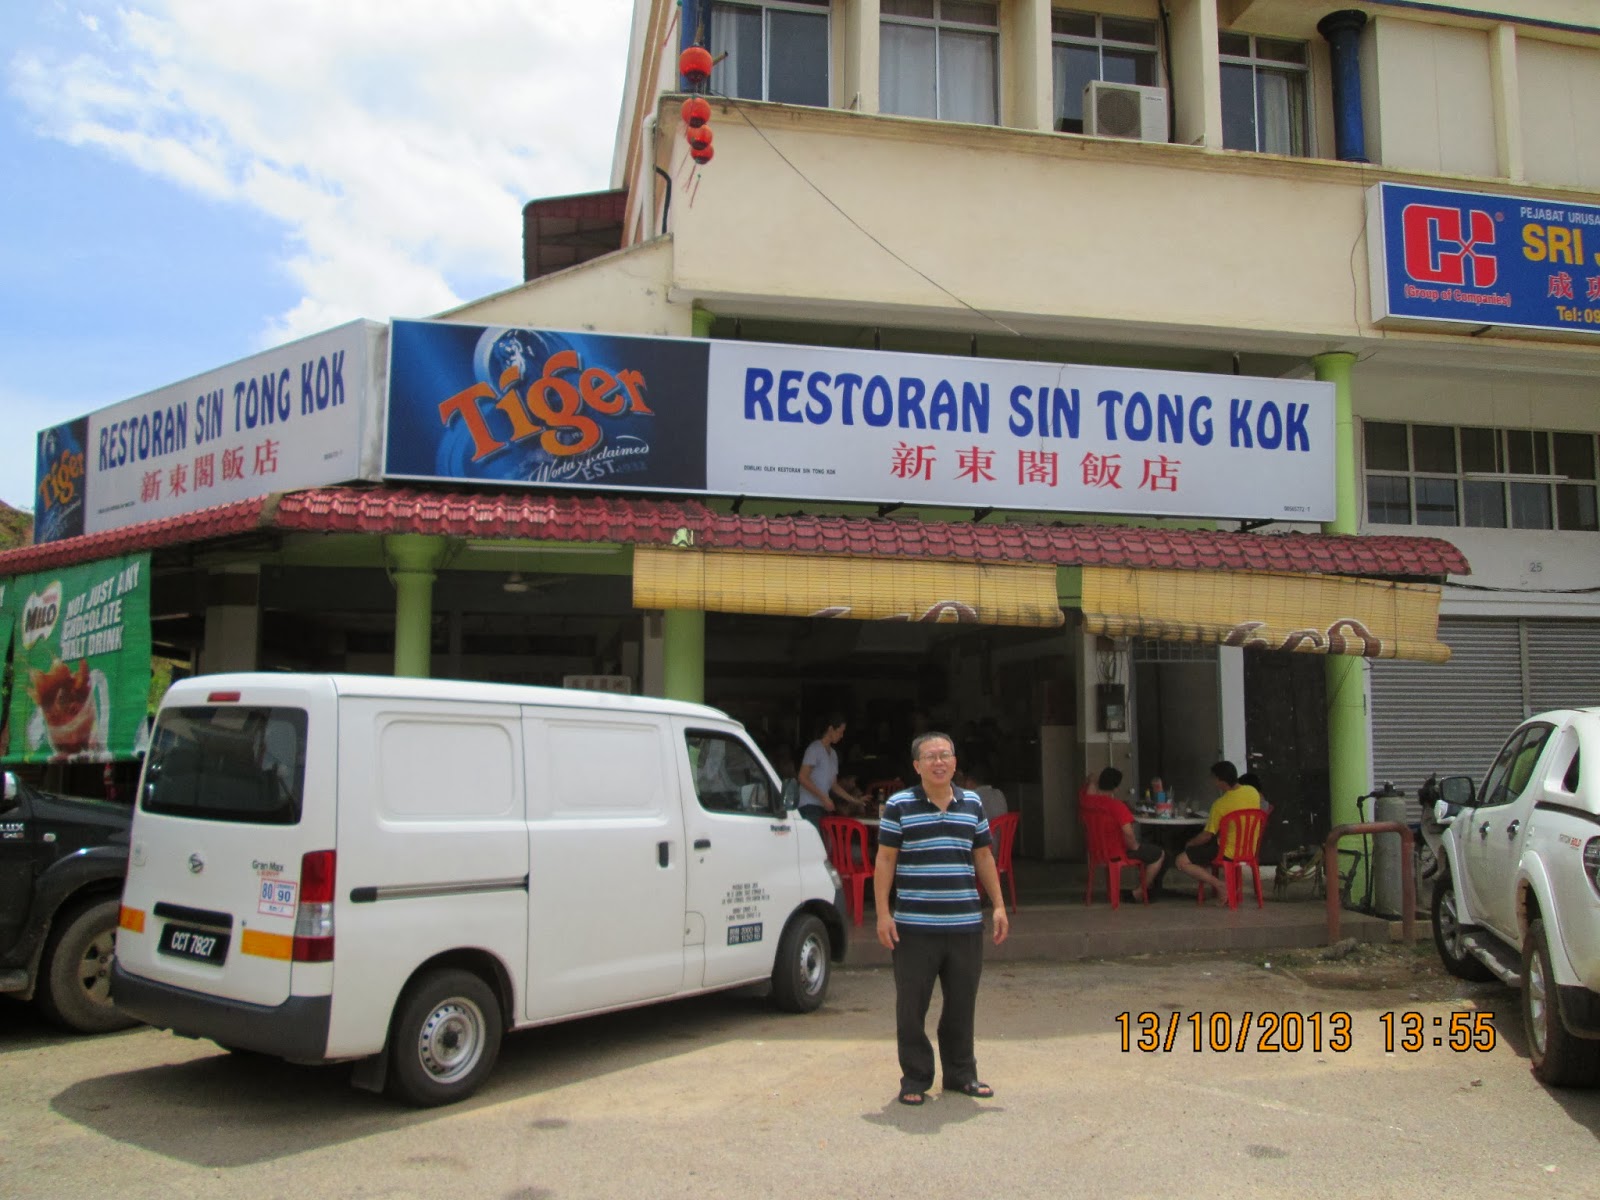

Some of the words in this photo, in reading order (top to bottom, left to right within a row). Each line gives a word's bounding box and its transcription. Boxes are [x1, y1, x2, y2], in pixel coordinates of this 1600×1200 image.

[1520, 206, 1564, 222] PEJABAT
[1522, 223, 1584, 265] SRI
[1441, 288, 1452, 300] of
[98, 401, 188, 471] RESTORAN
[195, 388, 224, 445] SIN
[234, 368, 290, 432] TONG
[301, 350, 345, 416] KOK
[438, 350, 655, 463] Tiger
[744, 367, 990, 433] RESTORAN
[1008, 385, 1080, 439] SIN
[1097, 390, 1214, 446] TONG
[1230, 399, 1310, 452] KOK
[39, 449, 84, 510] Tiger
[140, 439, 280, 503] 新東閣飯店
[890, 441, 1182, 492] 新東閣飯店
[66, 593, 86, 620] NOT
[87, 576, 115, 610] JUST
[117, 561, 140, 596] ANY
[25, 604, 57, 633] MILO
[61, 598, 123, 641] CHOCOLATE
[252, 860, 268, 870] Gran
[270, 862, 284, 872] Max
[262, 883, 273, 900] 80
[277, 890, 291, 902] 90
[171, 931, 190, 951] CCT
[190, 934, 216, 956] 7827
